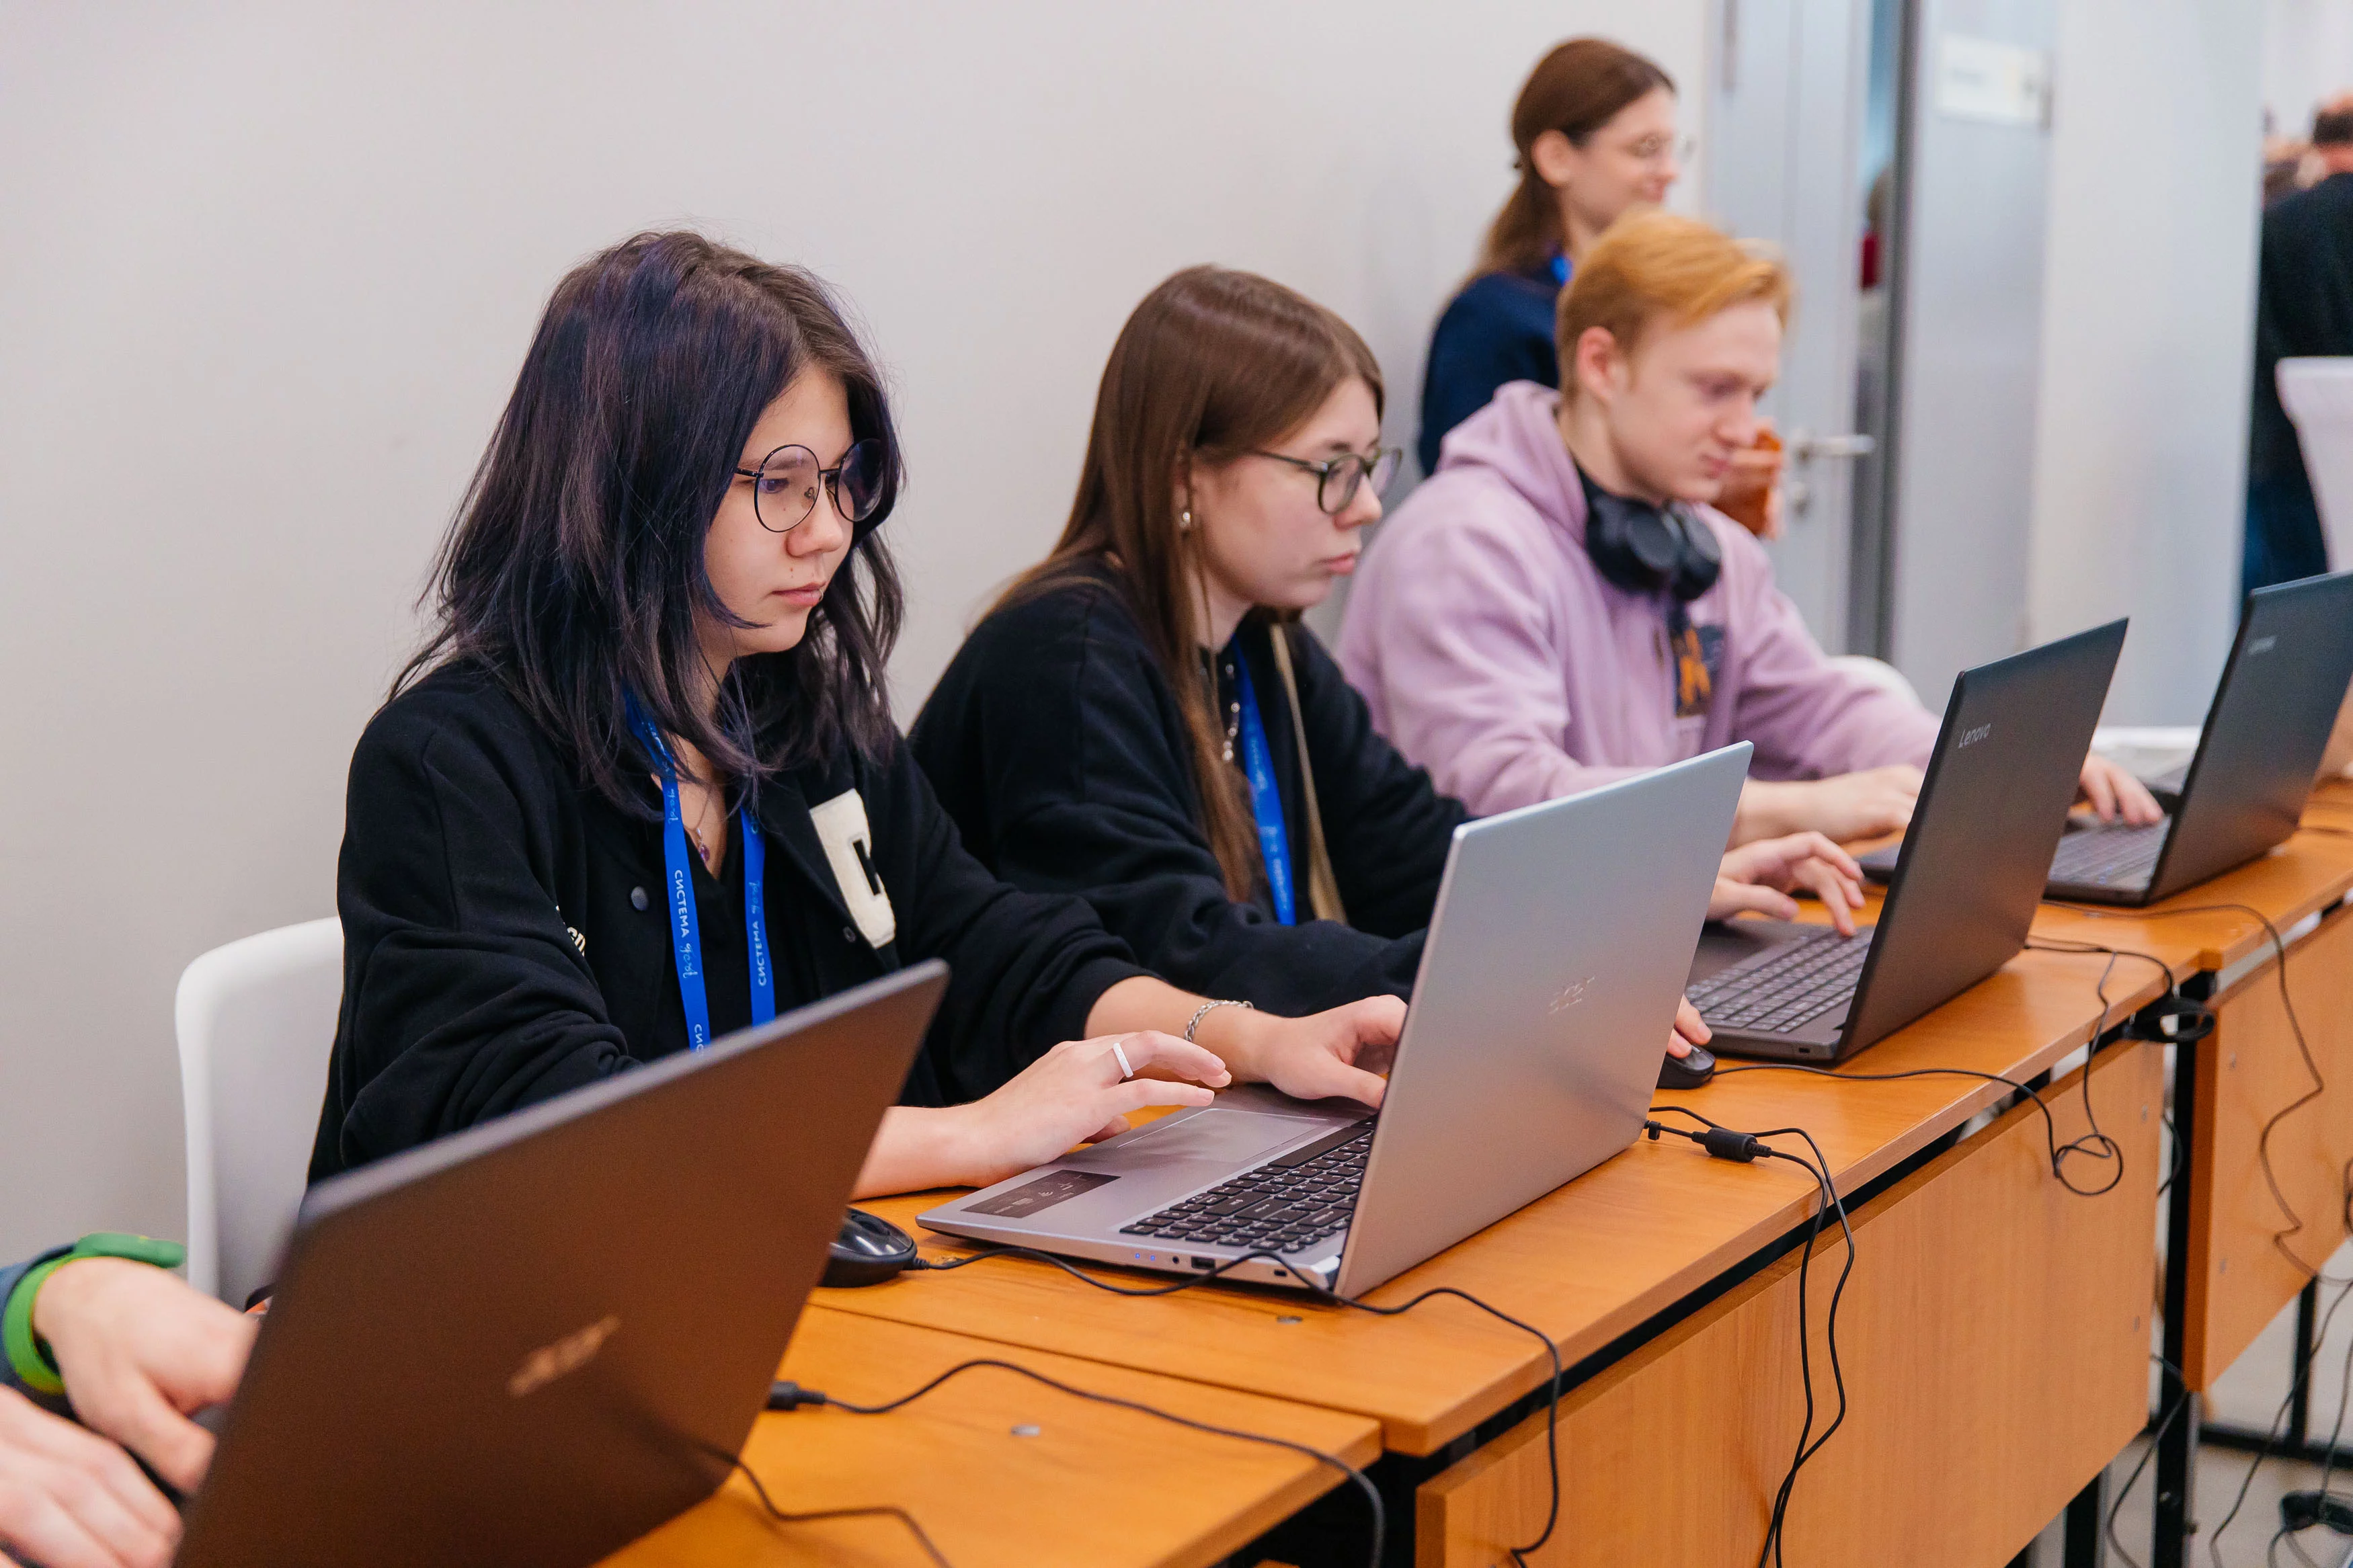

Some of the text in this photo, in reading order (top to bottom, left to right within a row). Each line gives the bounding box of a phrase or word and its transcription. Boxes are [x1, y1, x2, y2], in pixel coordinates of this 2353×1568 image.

[1958, 723, 1991, 748] Lenovo
[674, 870, 690, 938] СИСТЕМА
[752, 921, 767, 987] СИСТЕМА
